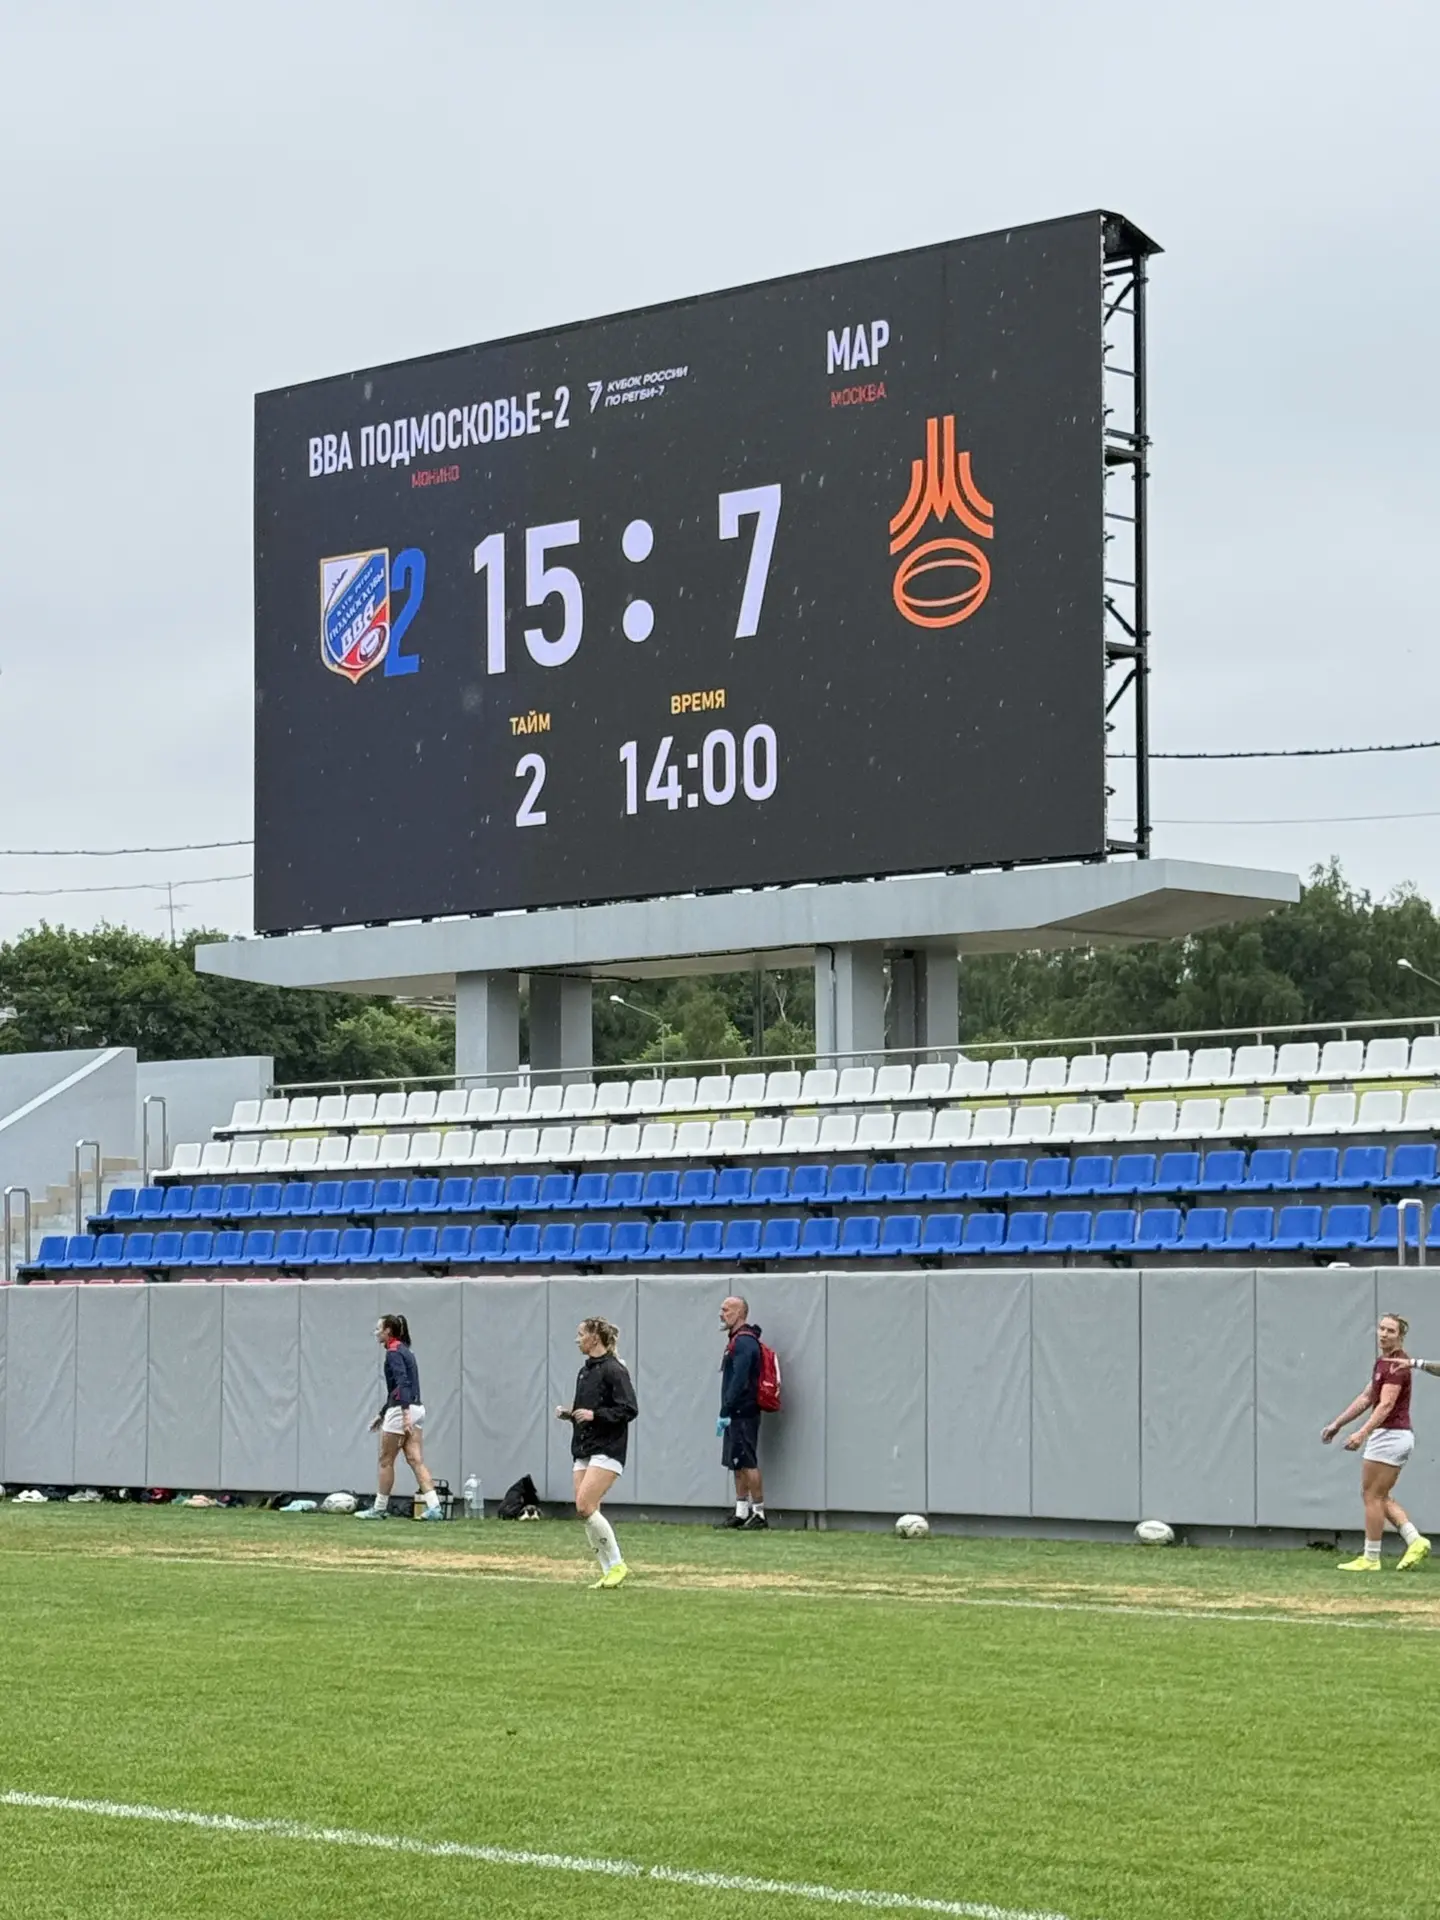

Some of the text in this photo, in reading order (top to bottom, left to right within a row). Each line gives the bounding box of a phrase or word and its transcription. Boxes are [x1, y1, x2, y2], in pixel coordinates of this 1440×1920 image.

[826, 319, 890, 375] МАР
[604, 385, 665, 407] ПО РЕГБИ-7
[606, 365, 689, 393] КУБОК РОССИИ
[830, 382, 887, 408] МОСКВА
[308, 385, 570, 478] ВВА ПОДМОСКОВЬЕ-2
[411, 464, 461, 489] МОНИНО
[473, 518, 584, 675] 15
[718, 483, 782, 639] 7
[383, 547, 427, 678] 2
[670, 688, 726, 715] ВРЕМЯ
[509, 710, 551, 736] ТАЙМ
[514, 752, 547, 828] 2
[619, 723, 778, 815] 14:00
